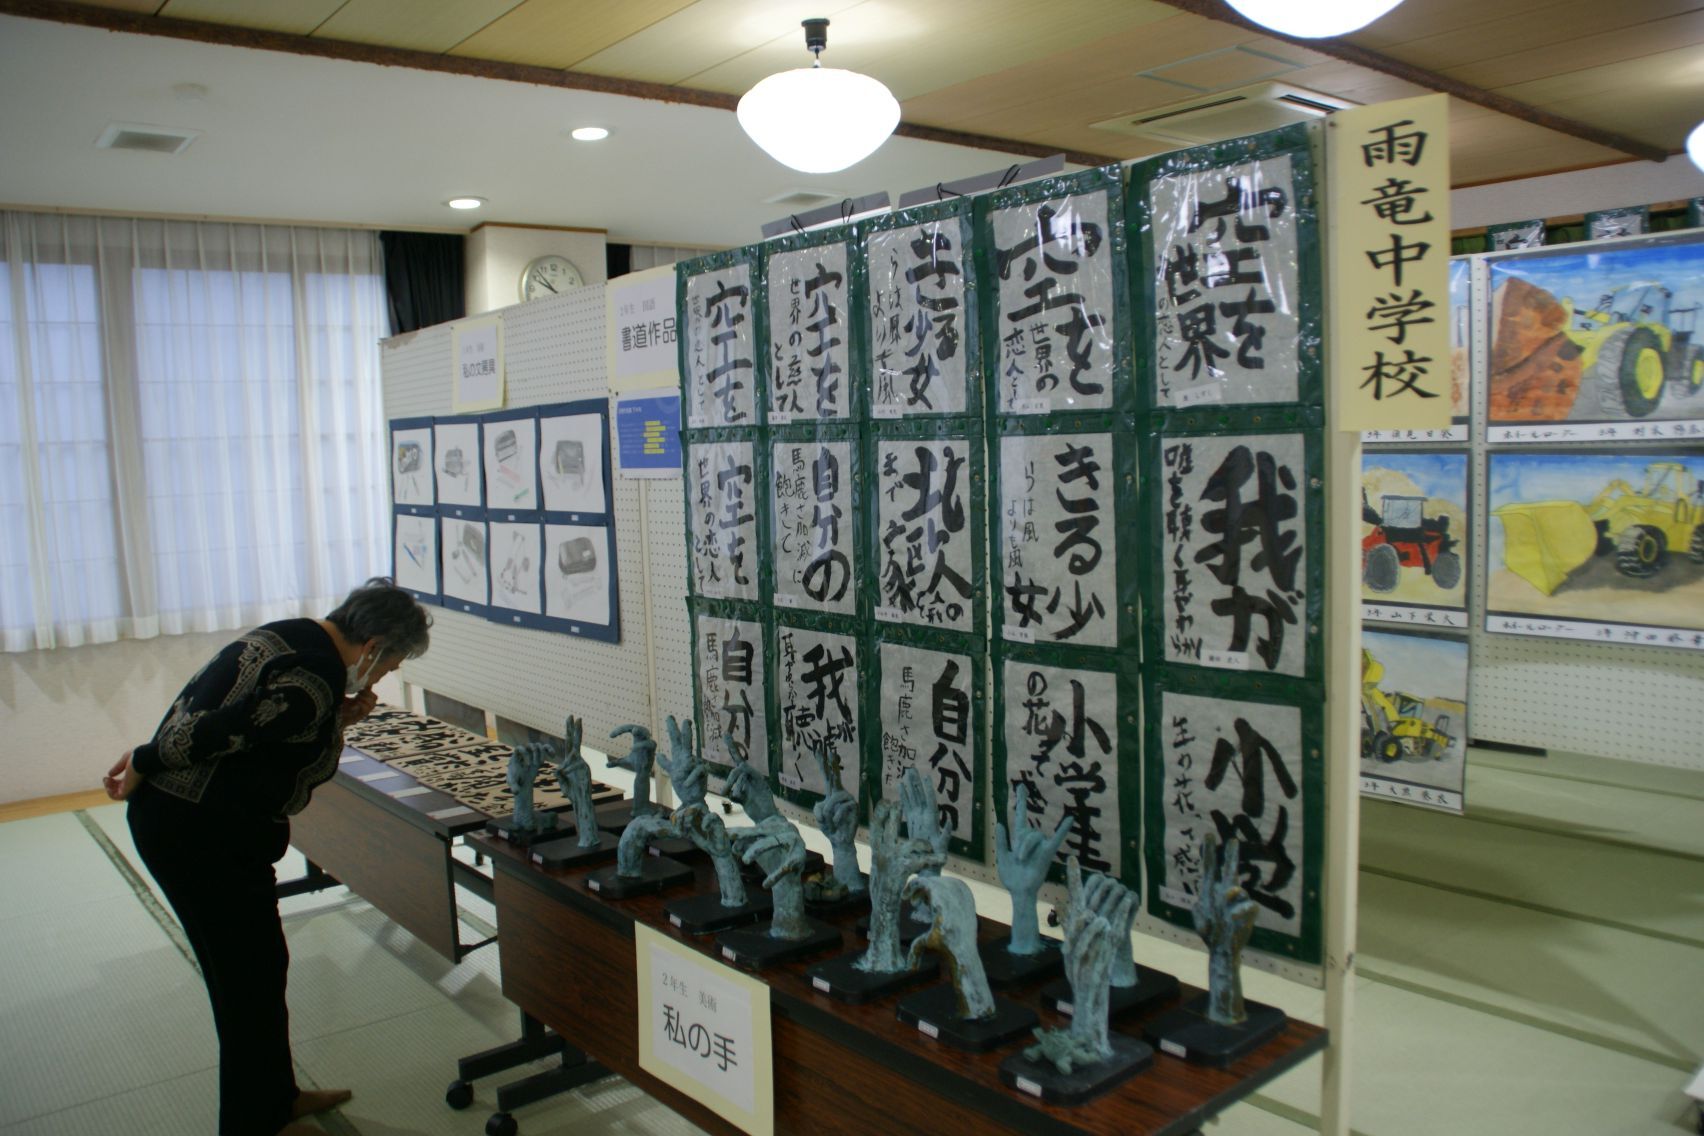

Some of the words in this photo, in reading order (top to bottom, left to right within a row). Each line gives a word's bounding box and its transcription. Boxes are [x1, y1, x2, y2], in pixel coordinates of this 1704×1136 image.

[621, 317, 677, 351] 書道作品
[999, 205, 1106, 395] 空を
[1188, 177, 1287, 369] 空を
[1360, 119, 1440, 401] 雨竜中学校
[704, 280, 753, 423] 空を
[805, 262, 842, 418] 空を
[717, 454, 754, 585] 空を
[802, 446, 850, 602] 自分の
[663, 1003, 738, 1072] 私の手
